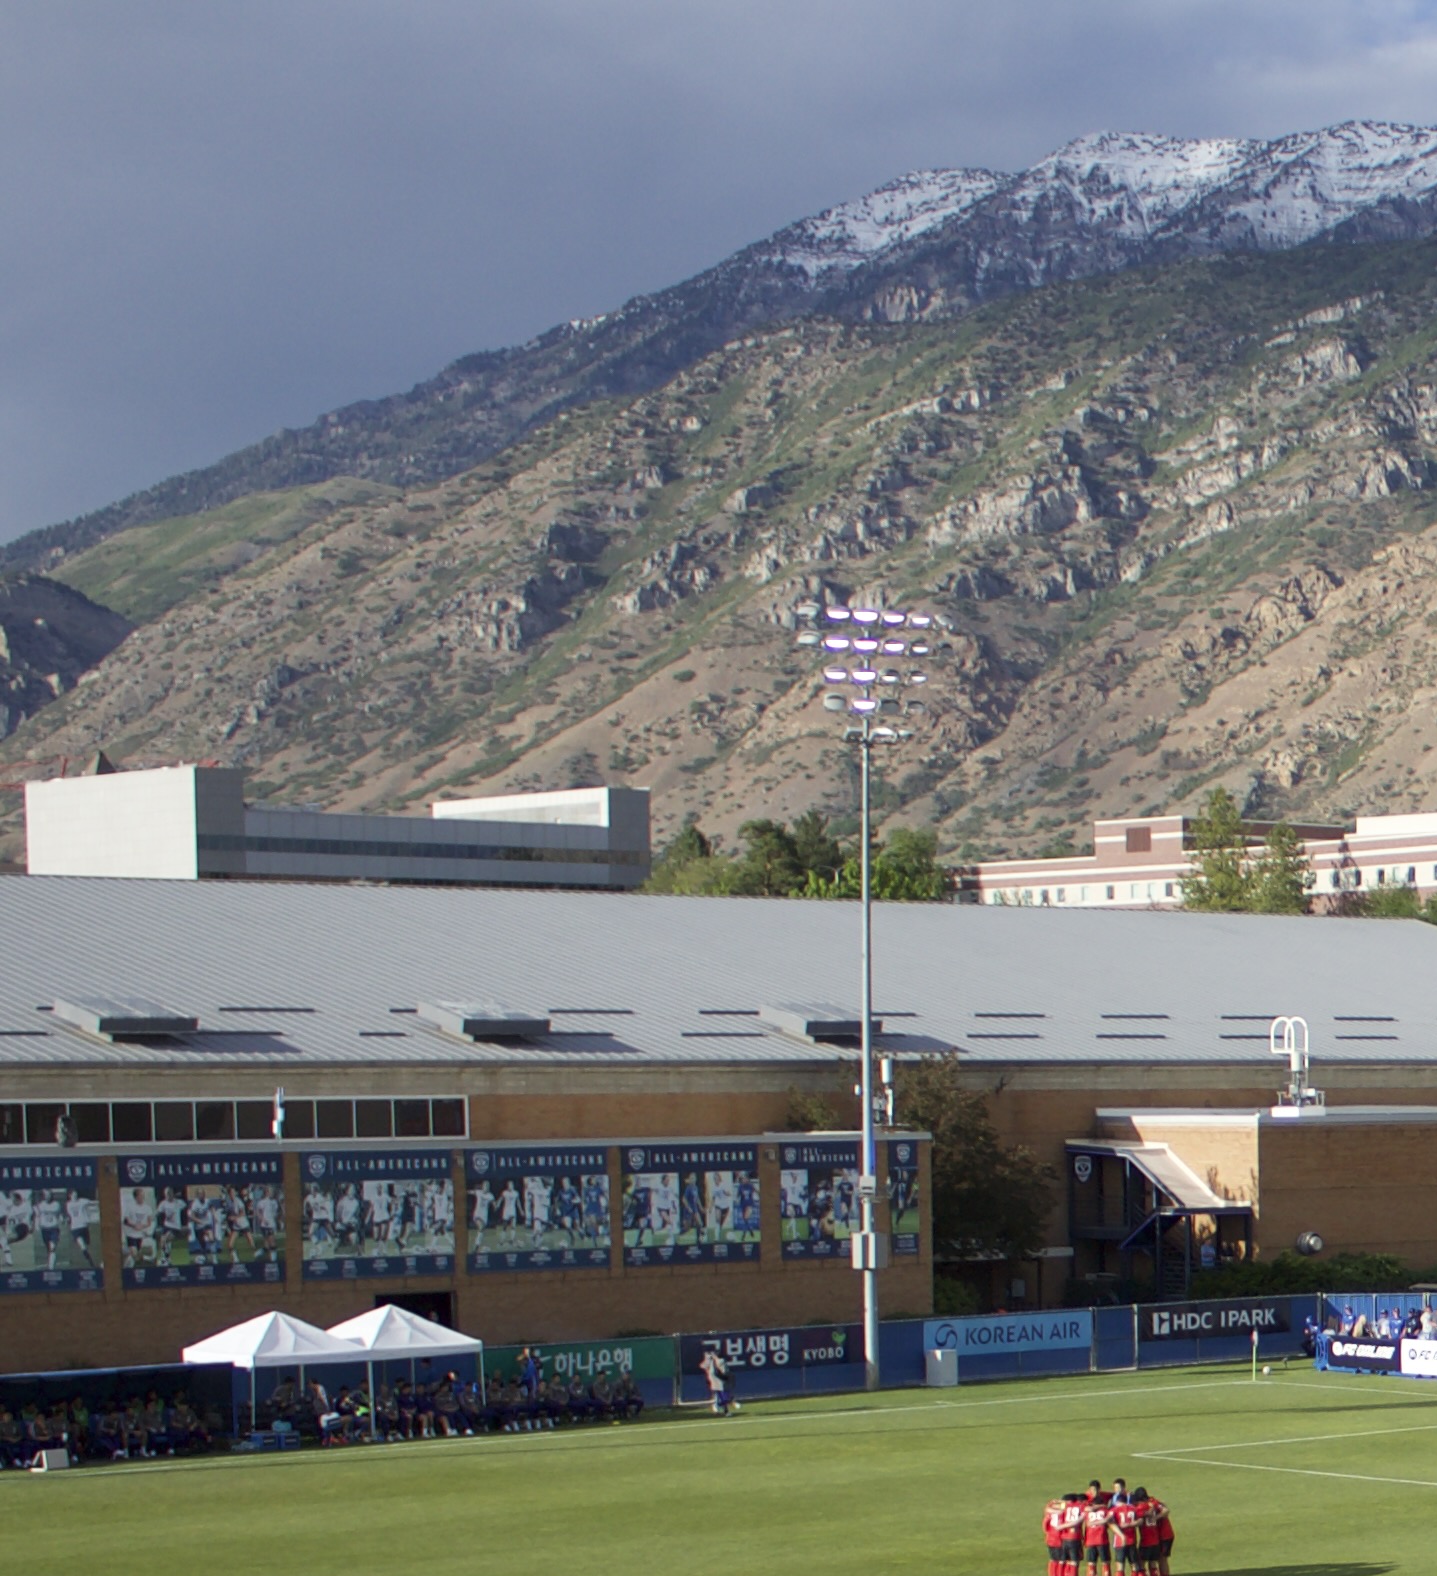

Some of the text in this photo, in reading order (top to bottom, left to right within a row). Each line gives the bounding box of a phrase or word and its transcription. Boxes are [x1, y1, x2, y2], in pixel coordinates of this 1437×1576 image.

[337, 1157, 447, 1171] ALL-AMERICANS
[500, 1154, 603, 1168] ALL-AMERICANS
[654, 1150, 753, 1164] ALL-AMERICANS
[159, 1161, 277, 1176] ALL-AMERICANS
[1173, 1311, 1212, 1331] HDC
[965, 1320, 1081, 1346] KOREAN AIR
[803, 1345, 845, 1361] KYOBO
[1419, 1350, 1431, 1360] FC
[554, 1346, 633, 1377] 하나은행
